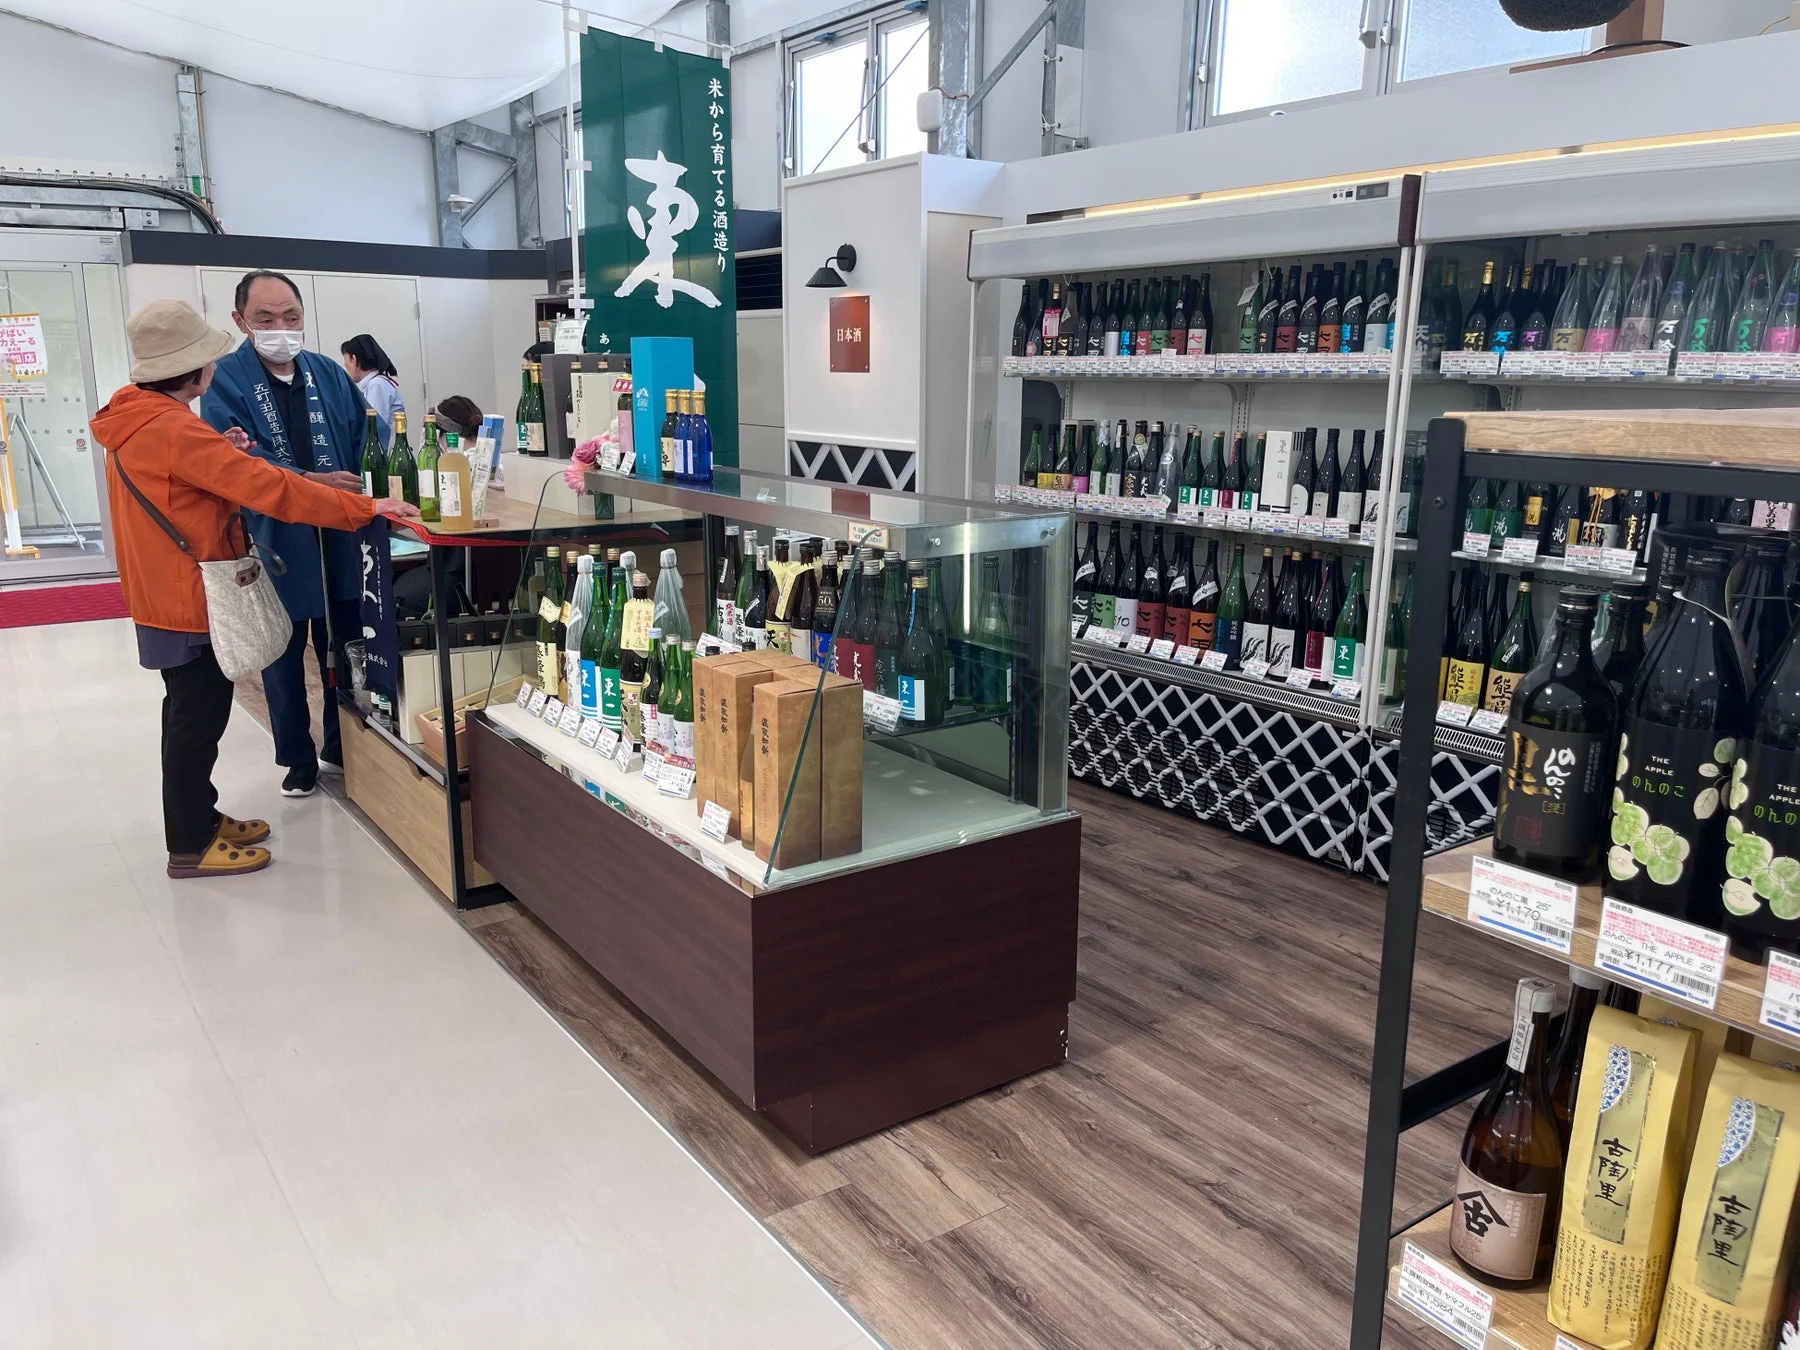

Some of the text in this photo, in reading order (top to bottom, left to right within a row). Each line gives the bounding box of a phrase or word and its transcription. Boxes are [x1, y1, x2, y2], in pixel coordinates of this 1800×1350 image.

[708, 77, 729, 273] 米から育てる酒造り
[614, 149, 722, 309] 東
[599, 332, 610, 345] あ
[836, 328, 862, 343] 日本酒
[1337, 644, 1350, 670] 東一
[604, 677, 617, 709] 東一
[1644, 765, 1675, 777] APPLE
[1651, 755, 1670, 765] THE
[1543, 747, 1576, 800] のんのこ
[1632, 775, 1685, 798] のんのこ
[1776, 783, 1798, 793] THE
[1753, 804, 1798, 826] のんの
[1602, 929, 1716, 973] のんのこ THE APPLE 25°
[1624, 948, 1674, 974] ¥1,177
[1594, 1137, 1632, 1208] 古陶里
[1707, 1194, 1753, 1267] 古陶里
